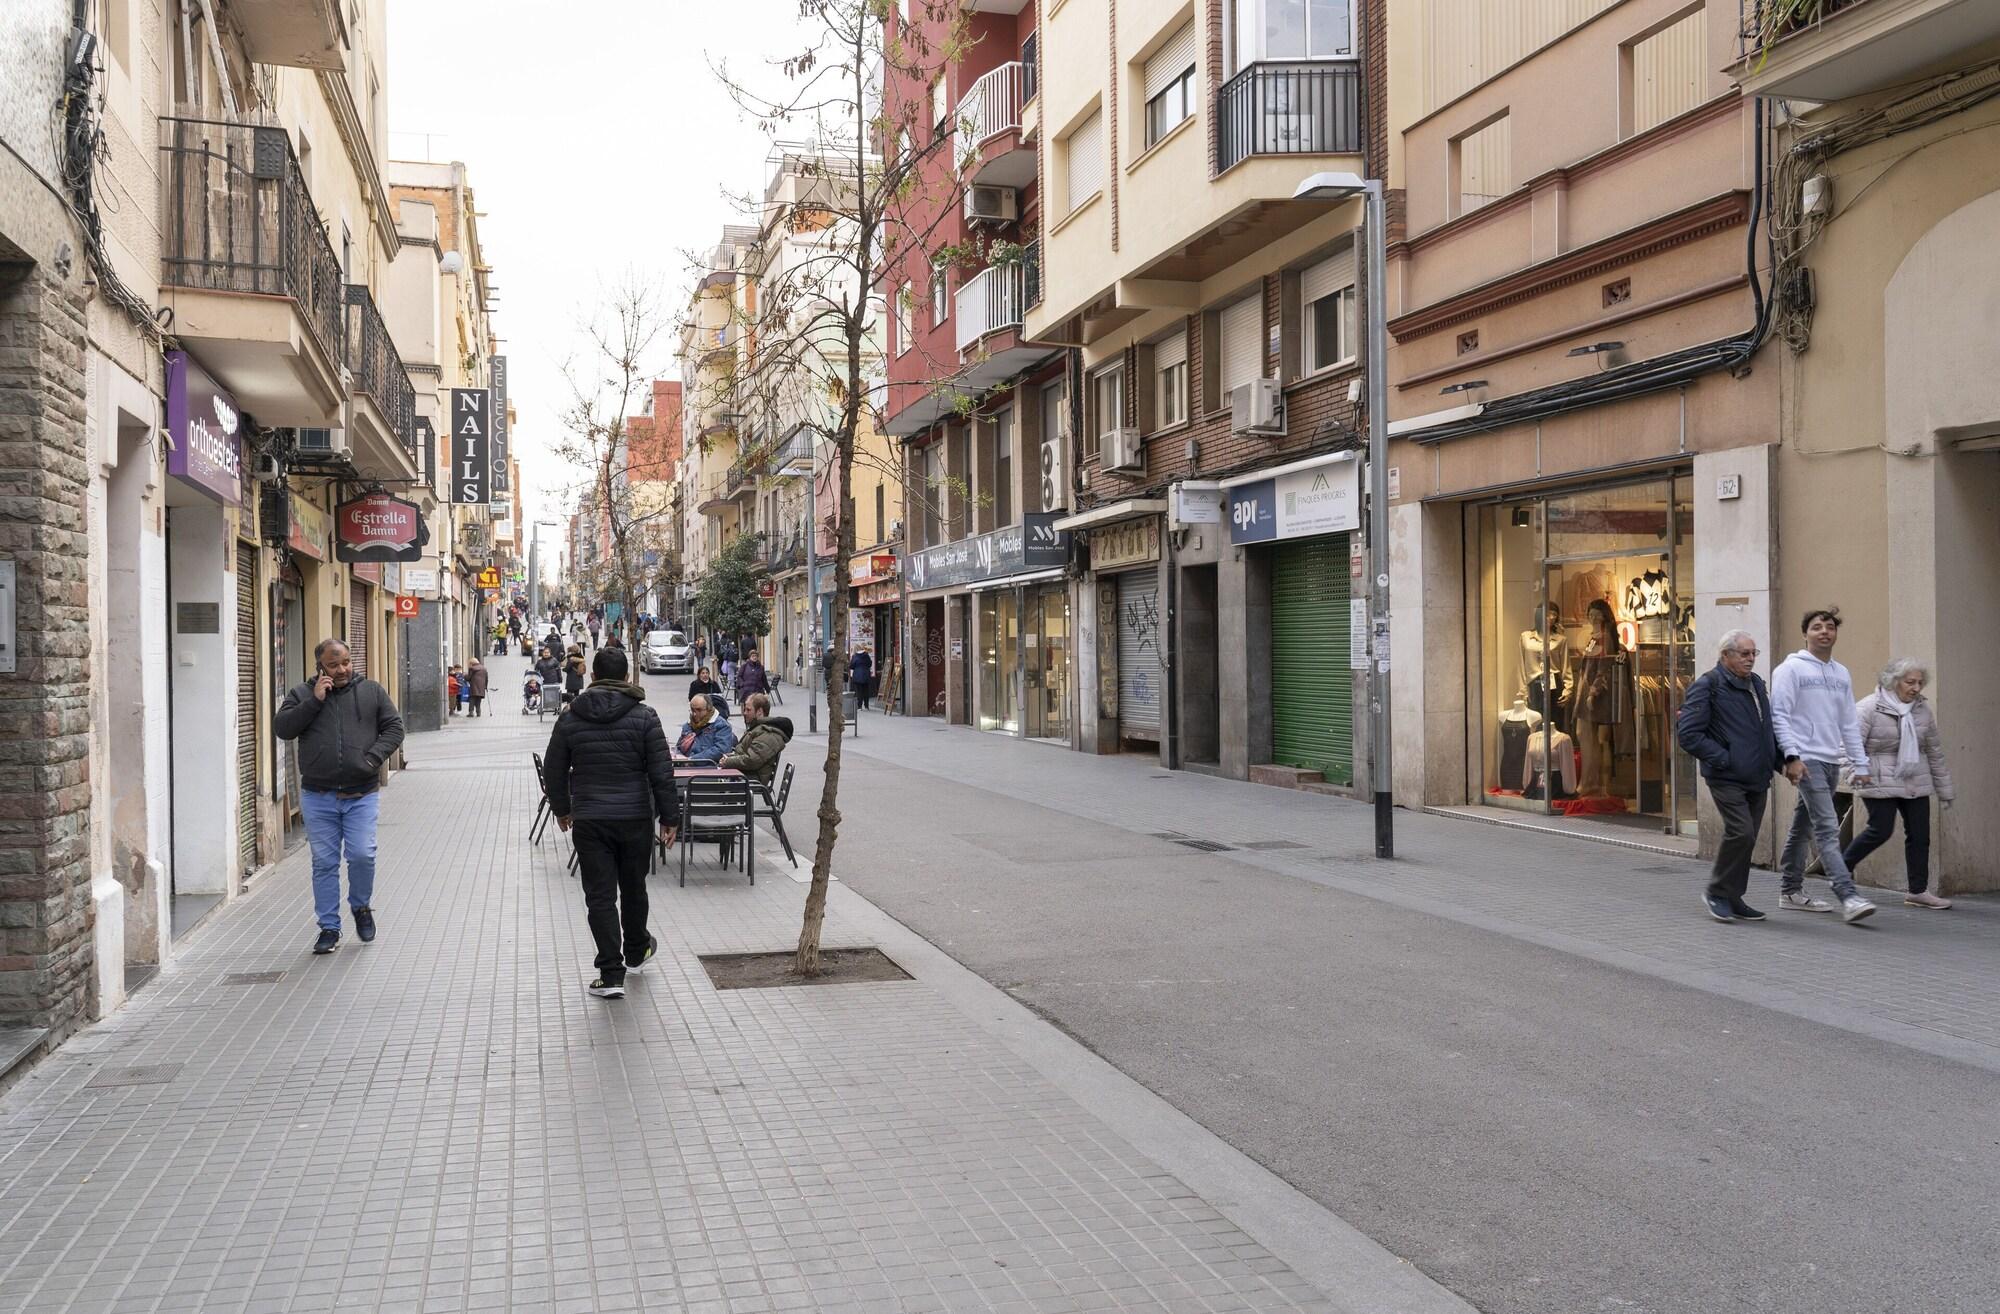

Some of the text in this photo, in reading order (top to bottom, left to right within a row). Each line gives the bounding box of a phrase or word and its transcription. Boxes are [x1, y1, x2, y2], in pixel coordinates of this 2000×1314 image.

[190, 416, 239, 479] orthoestetic
[459, 392, 481, 503] NAILS
[1722, 479, 1735, 495] 62
[351, 509, 407, 525] Estrella
[361, 524, 398, 536] Damm
[999, 536, 1022, 554] Mobles
[929, 552, 945, 569] Mobles
[945, 551, 955, 566] San
[1648, 592, 1660, 607] 12
